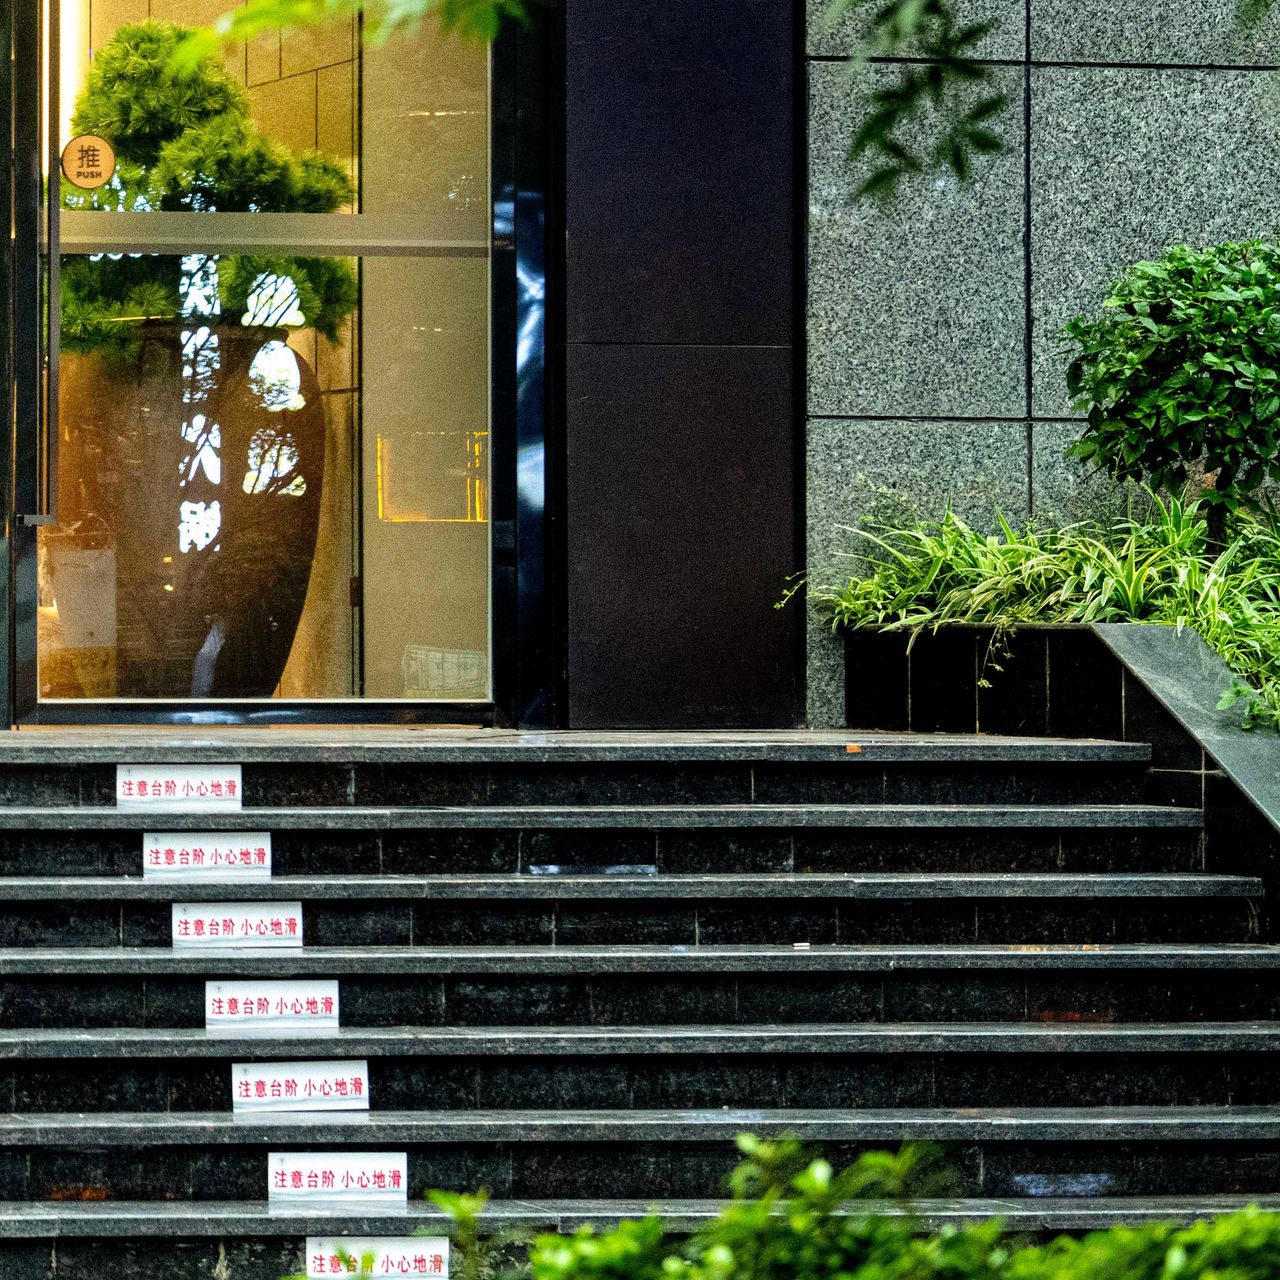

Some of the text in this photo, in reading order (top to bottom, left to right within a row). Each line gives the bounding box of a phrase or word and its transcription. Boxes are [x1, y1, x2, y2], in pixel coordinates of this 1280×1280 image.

[78, 145, 100, 168] 推
[122, 780, 237, 797] 注意台阶 小心地滑
[149, 847, 266, 865] 注意台阶 小心地滑
[178, 917, 298, 937] 注意台阶 小心地滑
[211, 996, 334, 1015] 注意台阶 小心地滑
[238, 1077, 363, 1098] 注意台阶 小心地滑
[274, 1169, 402, 1189] 注意台阶 小心地滑
[380, 1254, 442, 1275] 小心地滑
